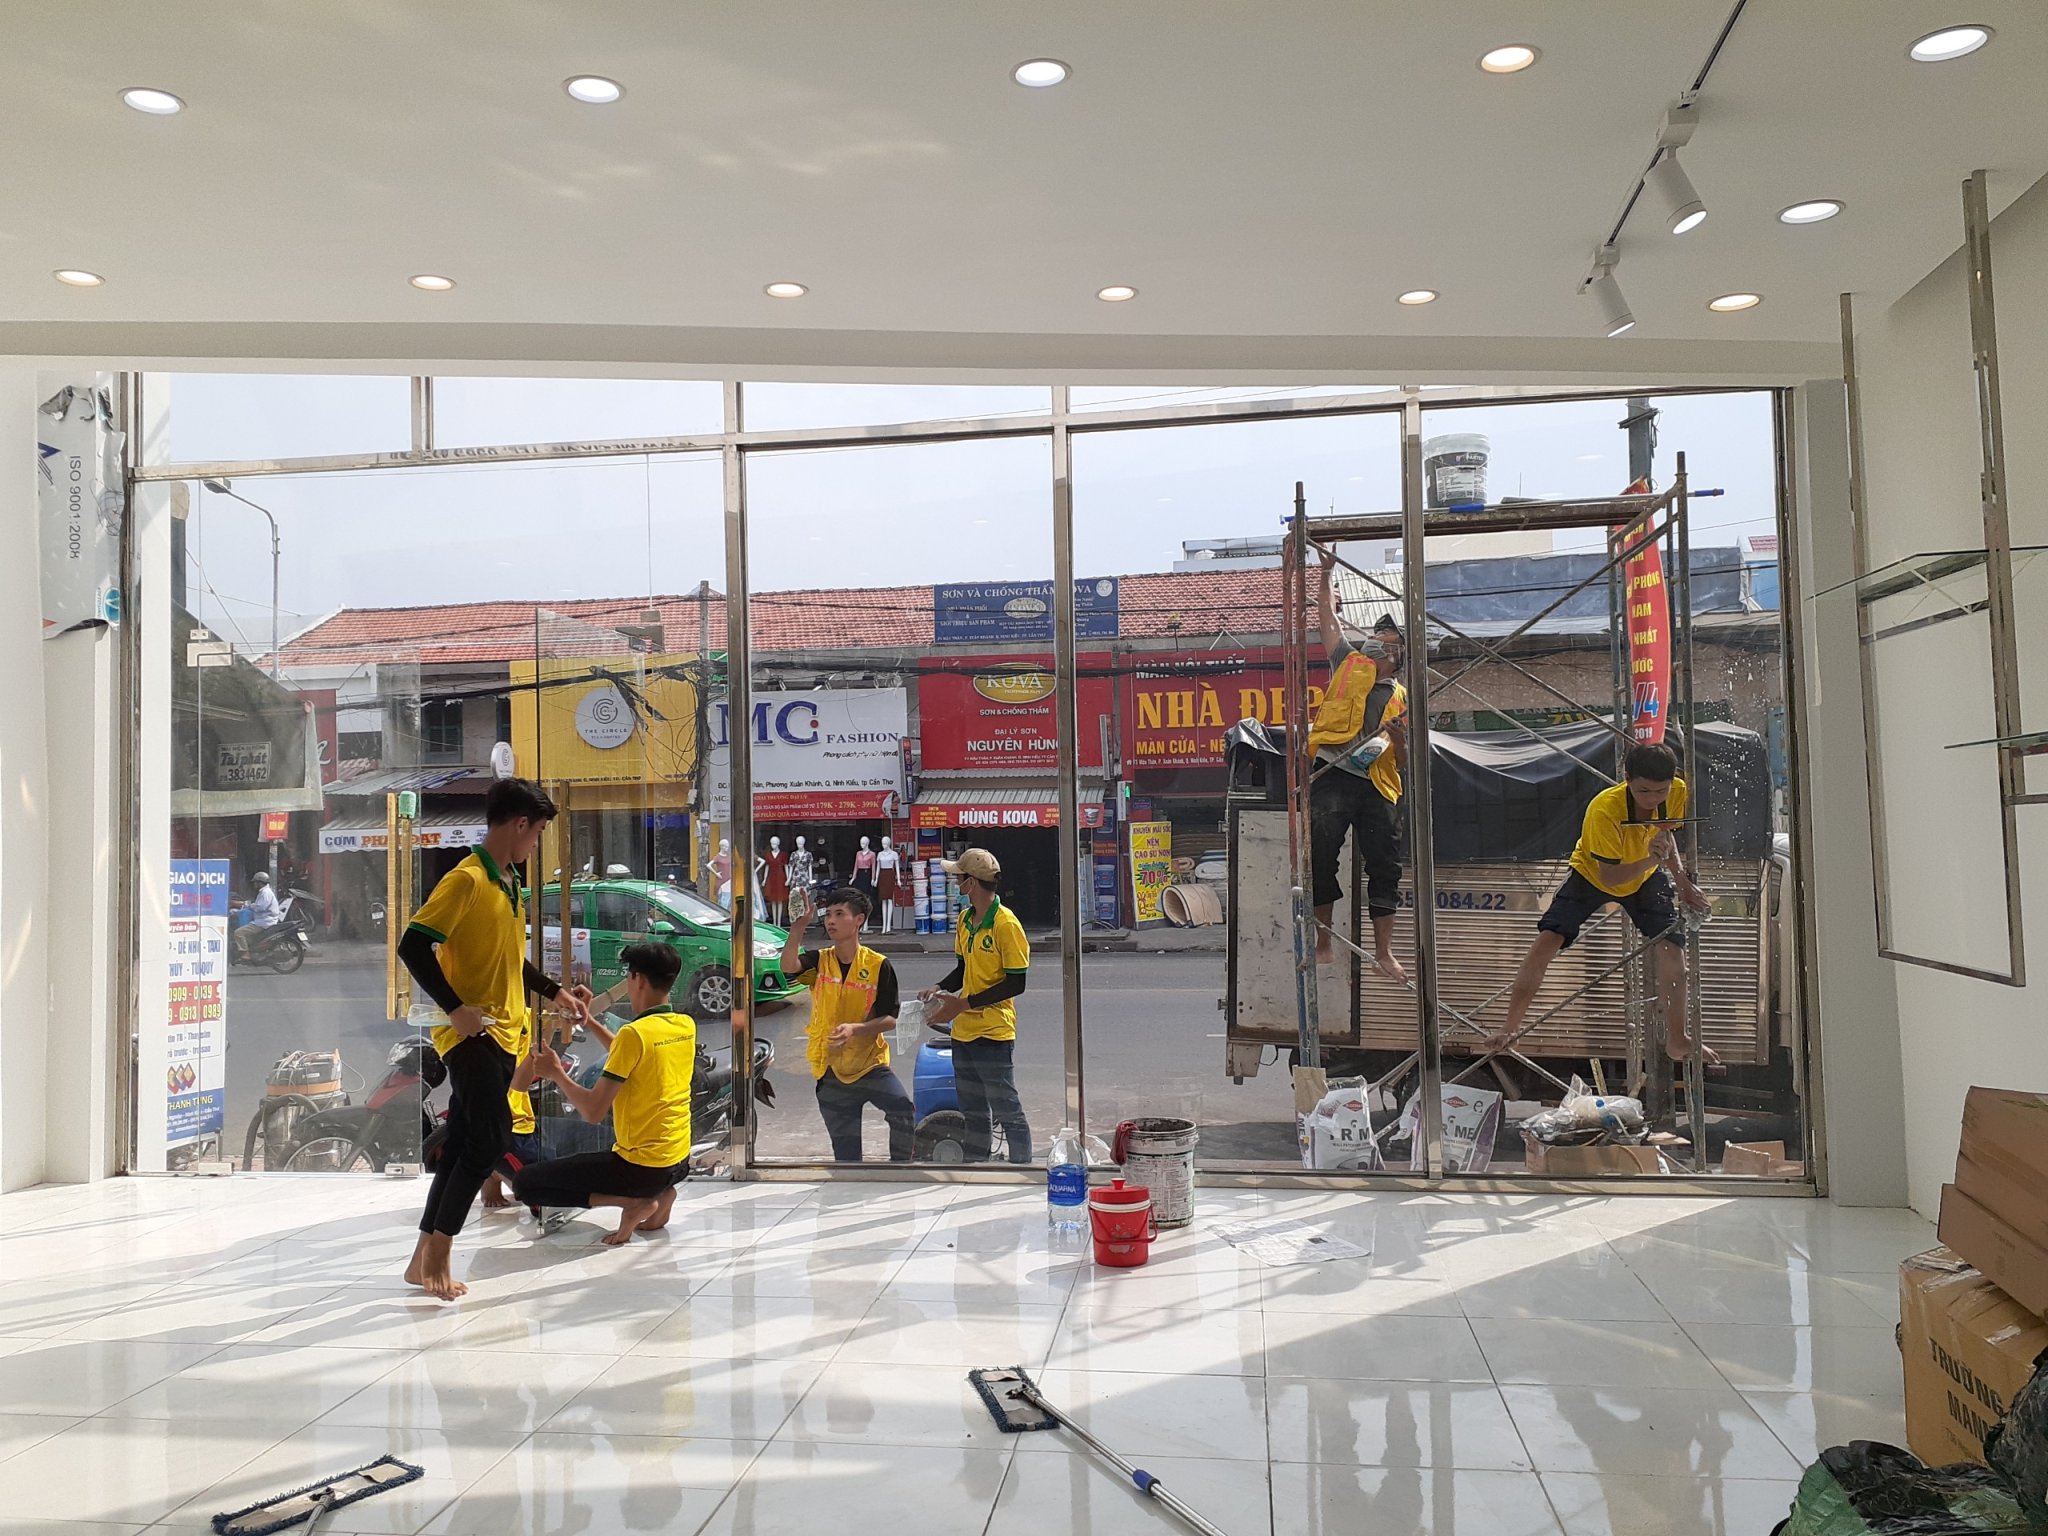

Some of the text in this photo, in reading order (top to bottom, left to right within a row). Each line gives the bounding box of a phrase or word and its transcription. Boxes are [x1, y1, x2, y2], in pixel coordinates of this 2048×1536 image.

[69, 456, 82, 559] ISO 9001:2008
[942, 587, 965, 599] SƠN
[967, 585, 981, 598] VÀ
[984, 584, 1023, 598] CHỐNG
[986, 673, 1043, 688] KOVA
[1002, 705, 1028, 715] CHỐNG
[1029, 705, 1049, 714] THẤM
[1136, 682, 1226, 729] NHÀ
[825, 732, 899, 744] FASHION
[995, 726, 1037, 736] ĐẠI LÝ SƠN
[1635, 726, 1653, 739] 2019
[967, 737, 1023, 752] NGUYÊN
[1136, 737, 1165, 755] MÀN
[1169, 734, 1196, 754] CỬA
[816, 801, 833, 809] 179K
[958, 807, 999, 825] HÙNG
[1002, 809, 1039, 825] KOVA
[324, 834, 356, 847] CƠM
[1135, 850, 1148, 859] CAO
[1140, 870, 1168, 885] 70%
[179, 1006, 197, 1021] 0913
[1050, 1183, 1077, 1194] AQUAFINA
